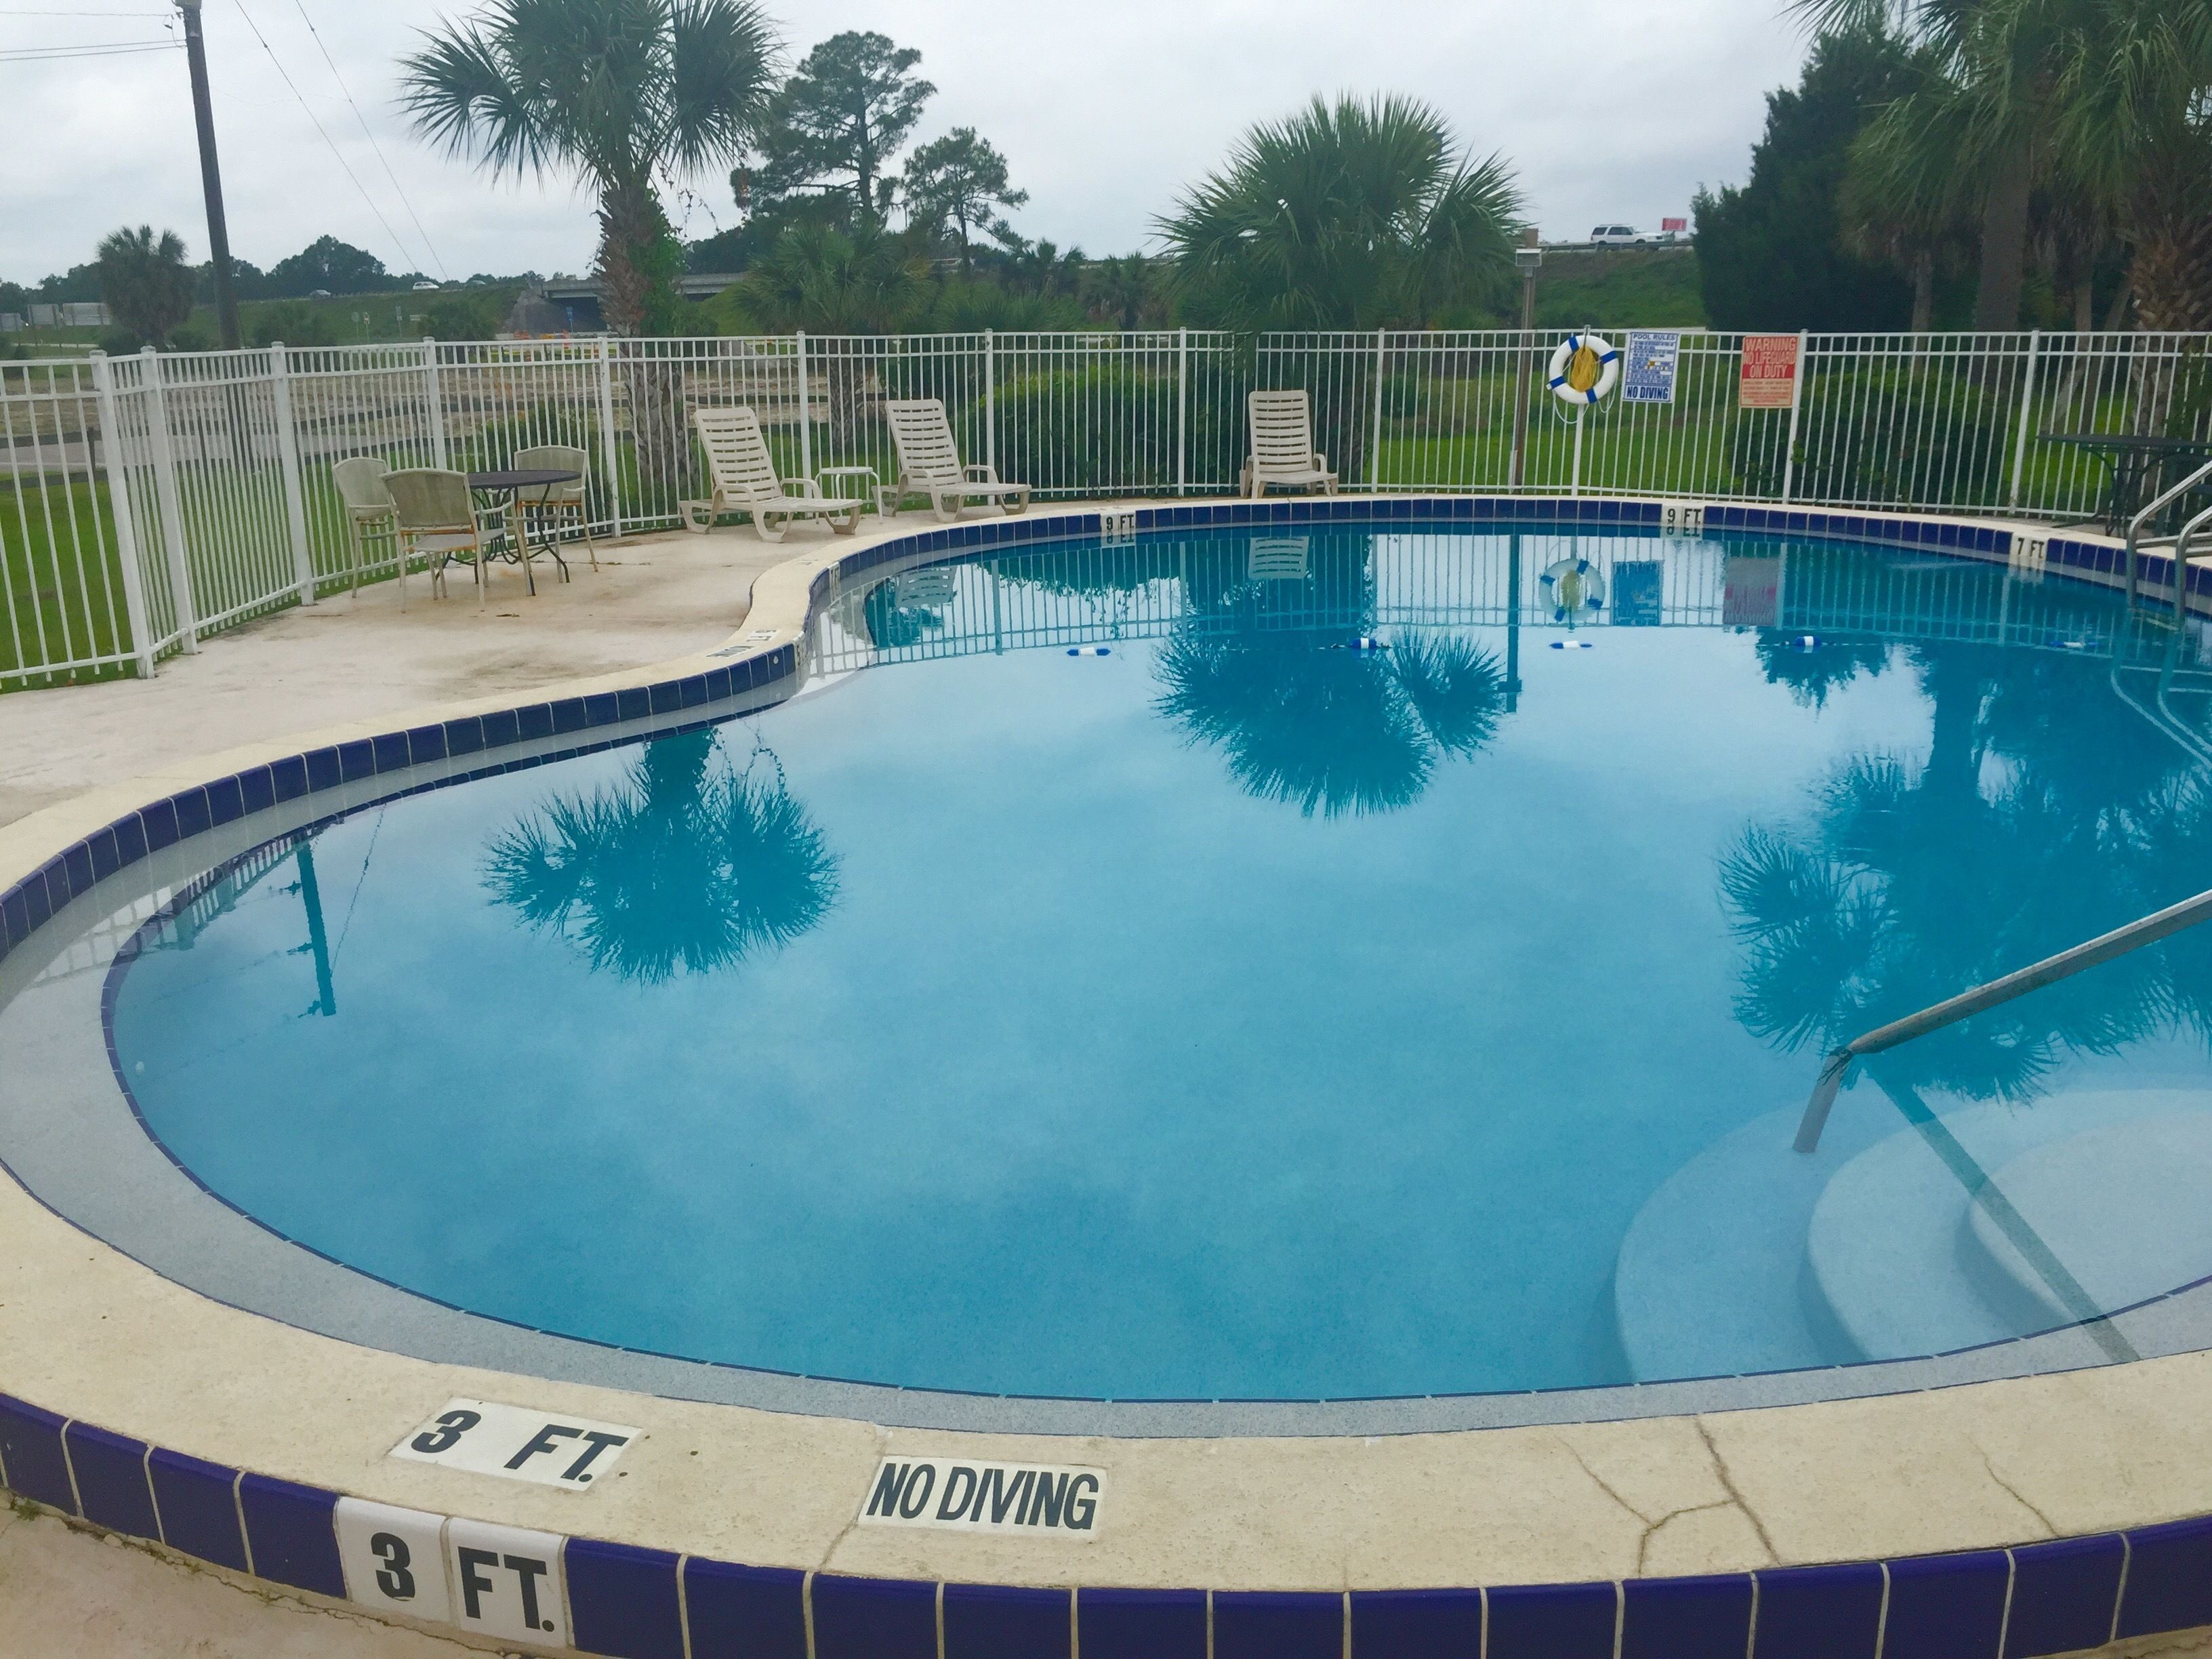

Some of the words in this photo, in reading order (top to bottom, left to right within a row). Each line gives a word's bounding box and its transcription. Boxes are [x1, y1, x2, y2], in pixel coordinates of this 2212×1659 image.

[1745, 337, 1797, 352] WARNING
[1744, 351, 1754, 365] NO
[1755, 351, 1796, 365] LIFEGUARD
[1749, 365, 1763, 378] ON
[1763, 365, 1788, 378] DUTY
[1626, 386, 1639, 398] NO
[1639, 386, 1669, 400] DIVING
[1667, 508, 1676, 523] 9
[1106, 516, 1113, 531] 9
[2018, 537, 2025, 555] 7
[411, 1409, 482, 1454] 3
[504, 1423, 629, 1483] FT.
[865, 1462, 937, 1519] NO
[935, 1466, 1100, 1530] DIVING
[371, 1532, 416, 1602] 3
[457, 1546, 556, 1633] FT.
